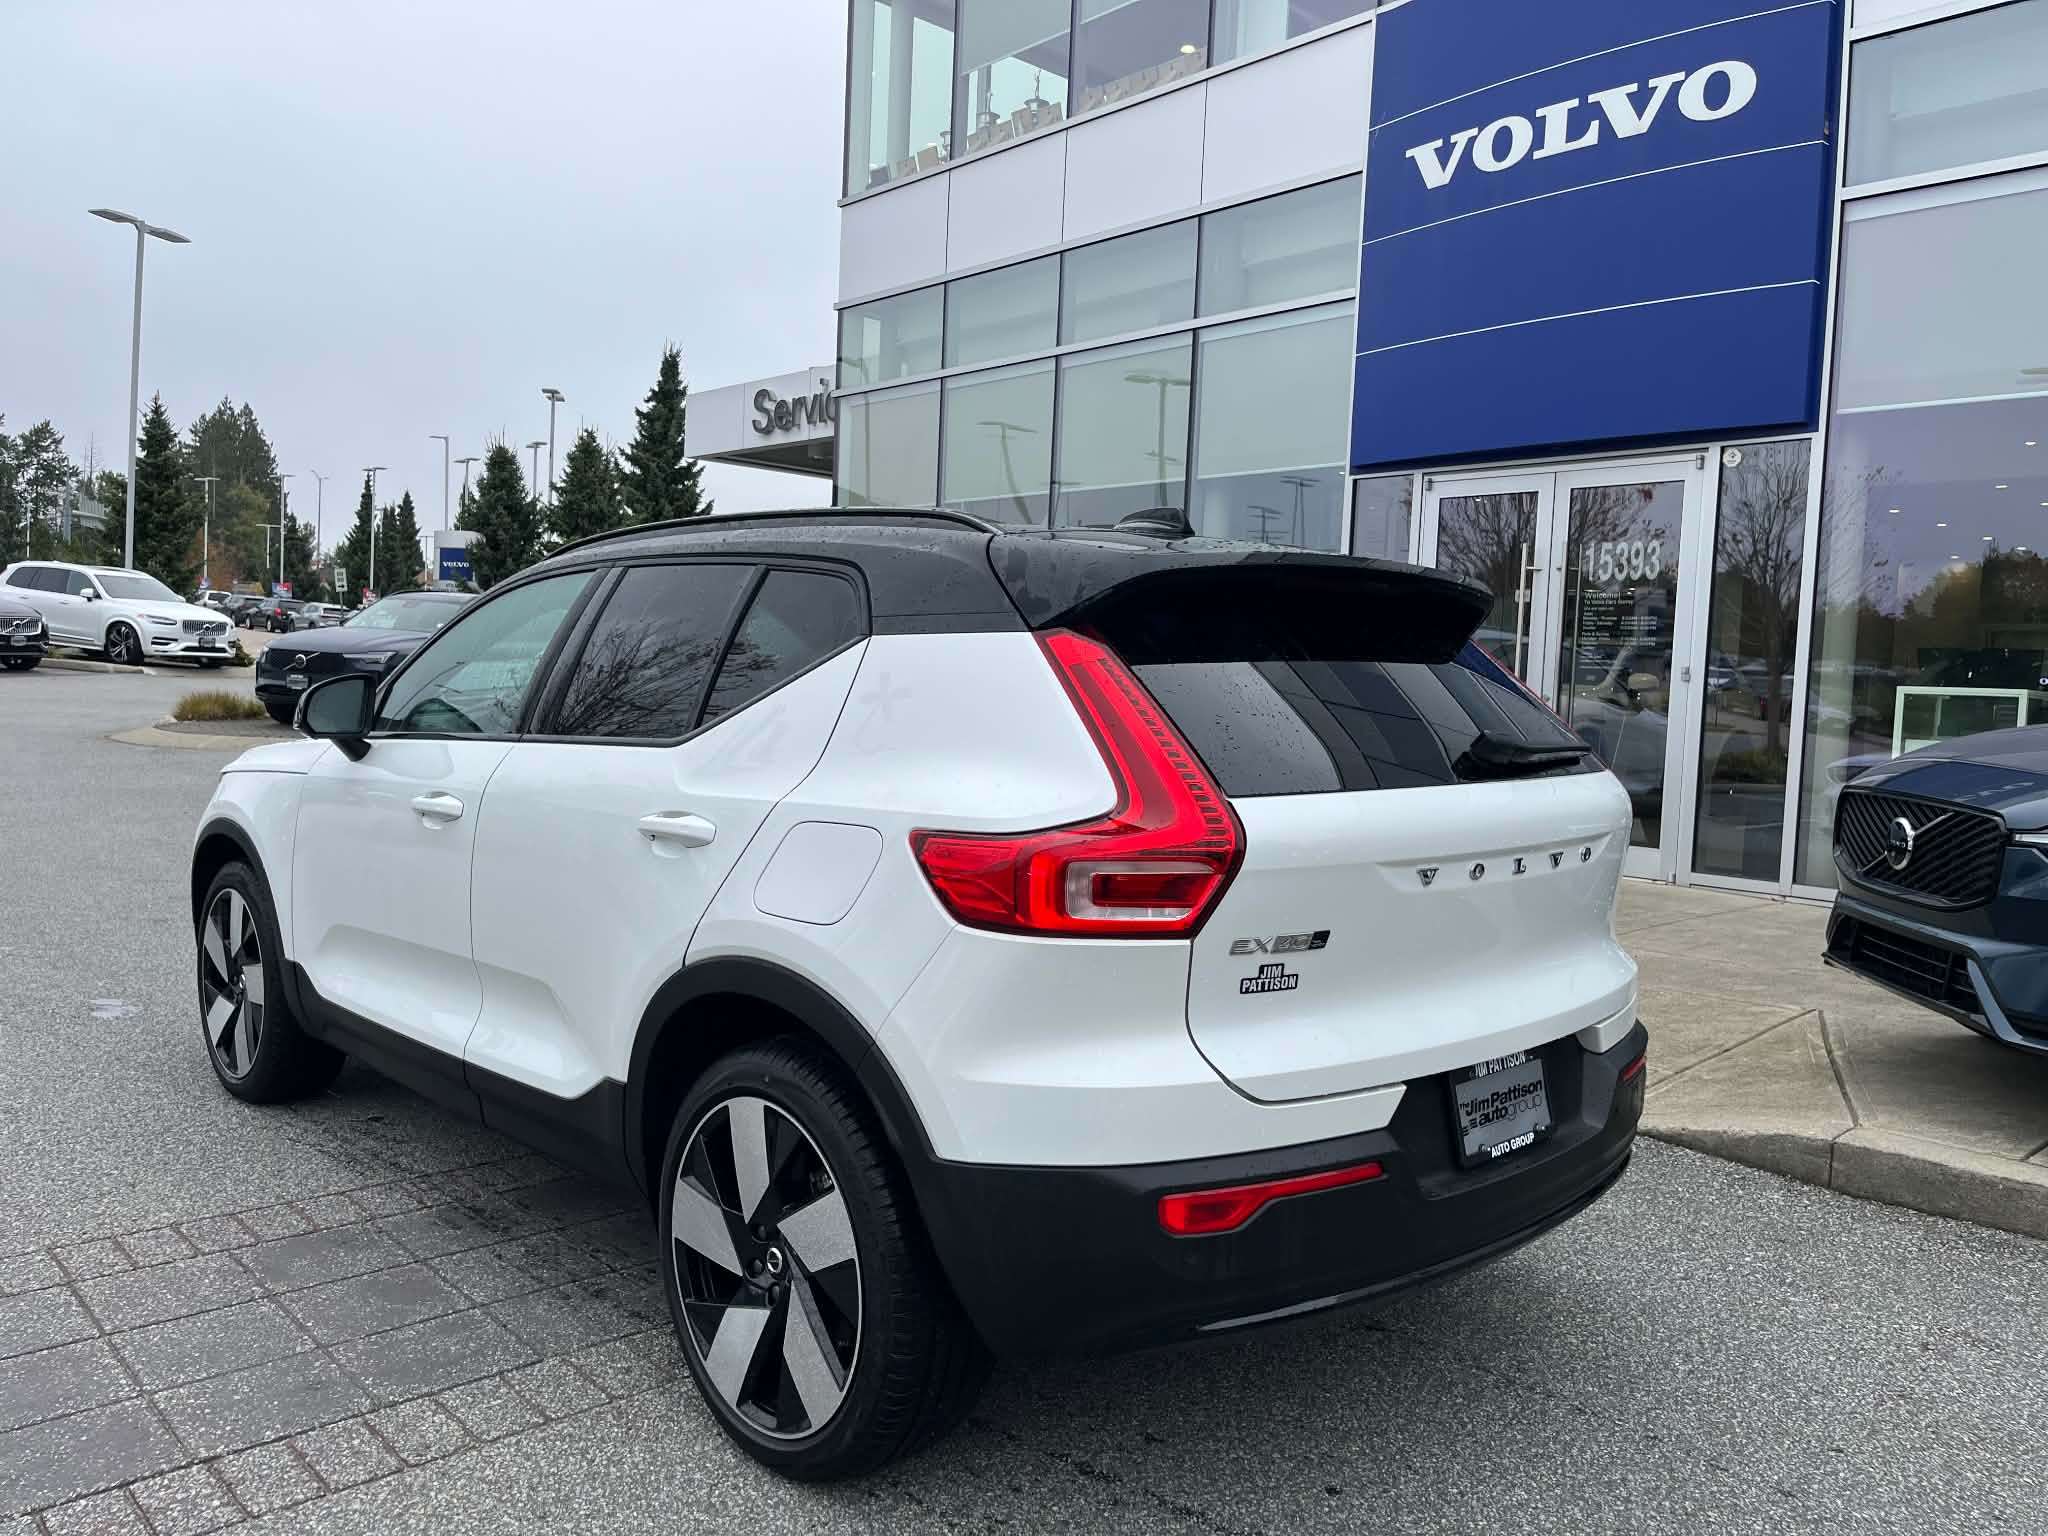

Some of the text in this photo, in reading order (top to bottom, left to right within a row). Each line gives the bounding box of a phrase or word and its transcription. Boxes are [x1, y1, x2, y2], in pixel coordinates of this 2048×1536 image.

[1405, 60, 1757, 190] VOLVO
[1585, 540, 1660, 581] 15393
[1416, 847, 1592, 888] VOLVO
[1241, 975, 1297, 993] PATTISON
[1260, 965, 1283, 979] JIM
[1474, 1050, 1528, 1078] JIM PATTISON
[1491, 1131, 1535, 1158] AUTO GROUP
